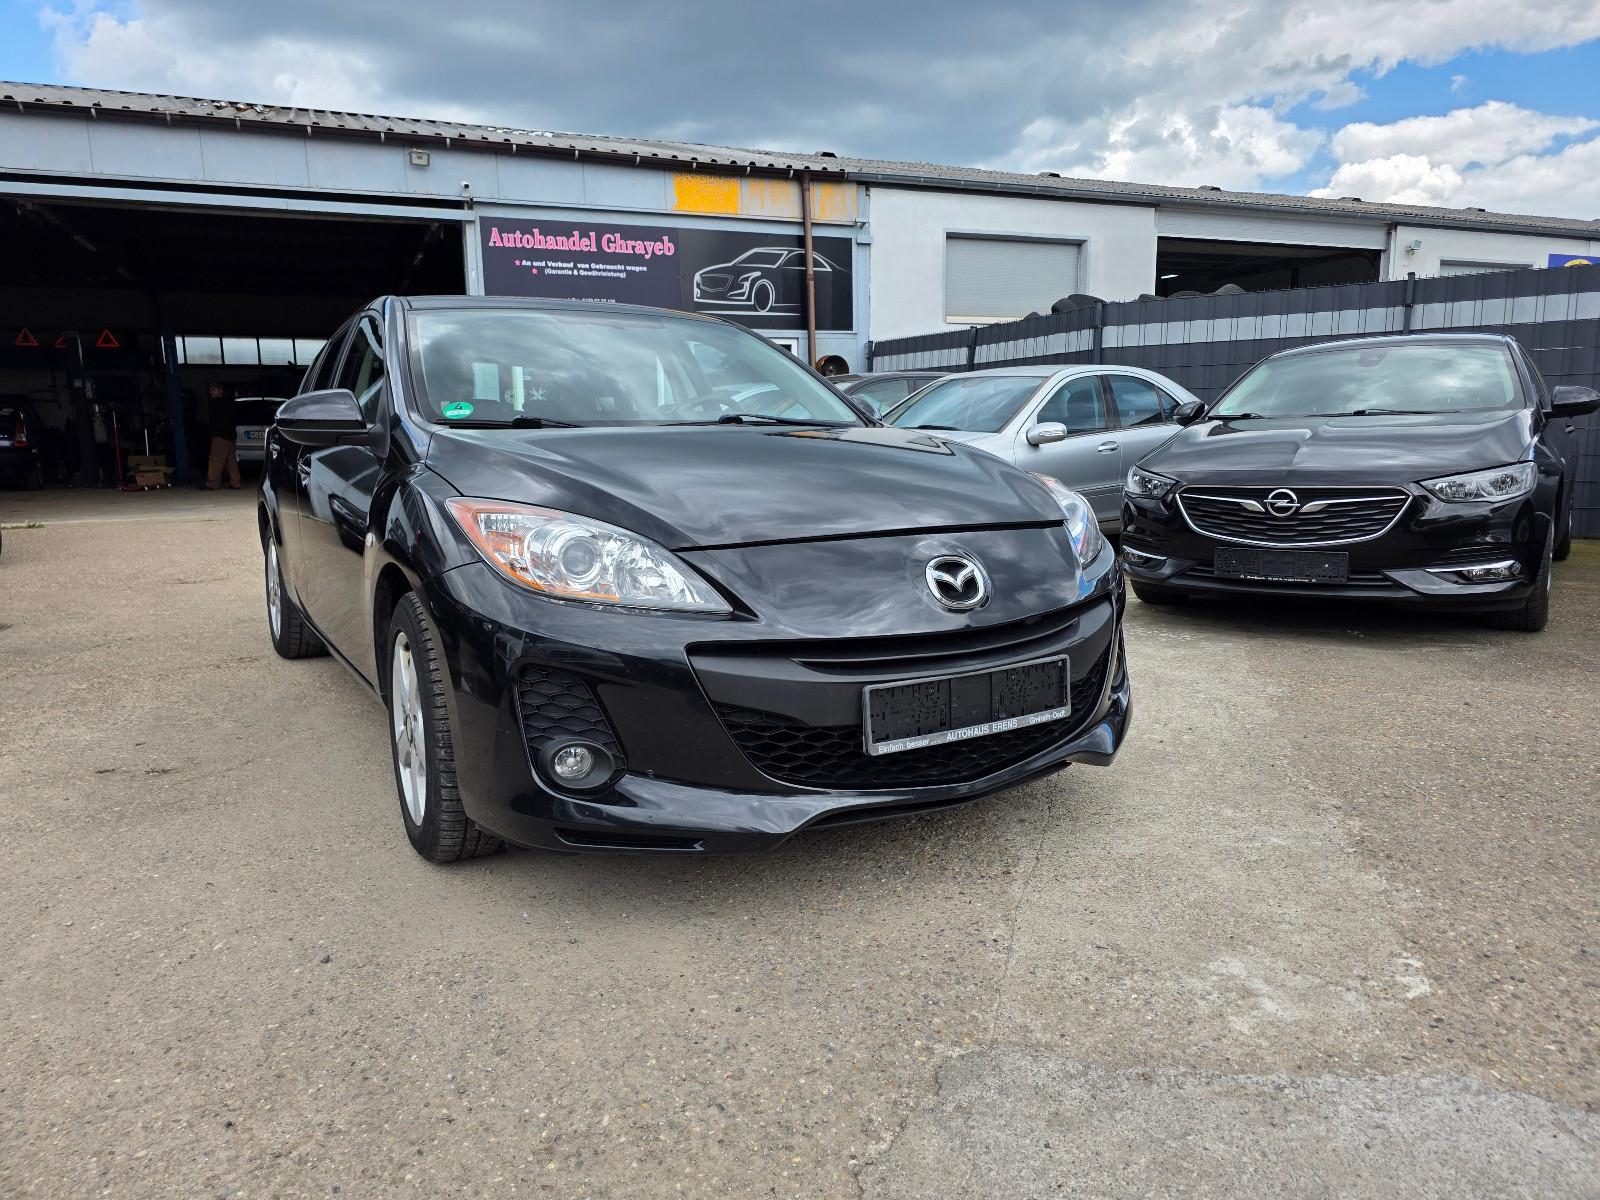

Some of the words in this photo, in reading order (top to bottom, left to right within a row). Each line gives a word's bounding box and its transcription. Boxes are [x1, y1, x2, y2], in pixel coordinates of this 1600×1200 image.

[488, 227, 597, 252] Autohandel
[601, 233, 675, 259] Ghrayeb
[591, 263, 625, 271] Gebraucht
[454, 402, 463, 410] 4
[878, 742, 904, 754] Einfach
[946, 725, 989, 741] AUTOHAUS
[992, 719, 1018, 732] ERENS
